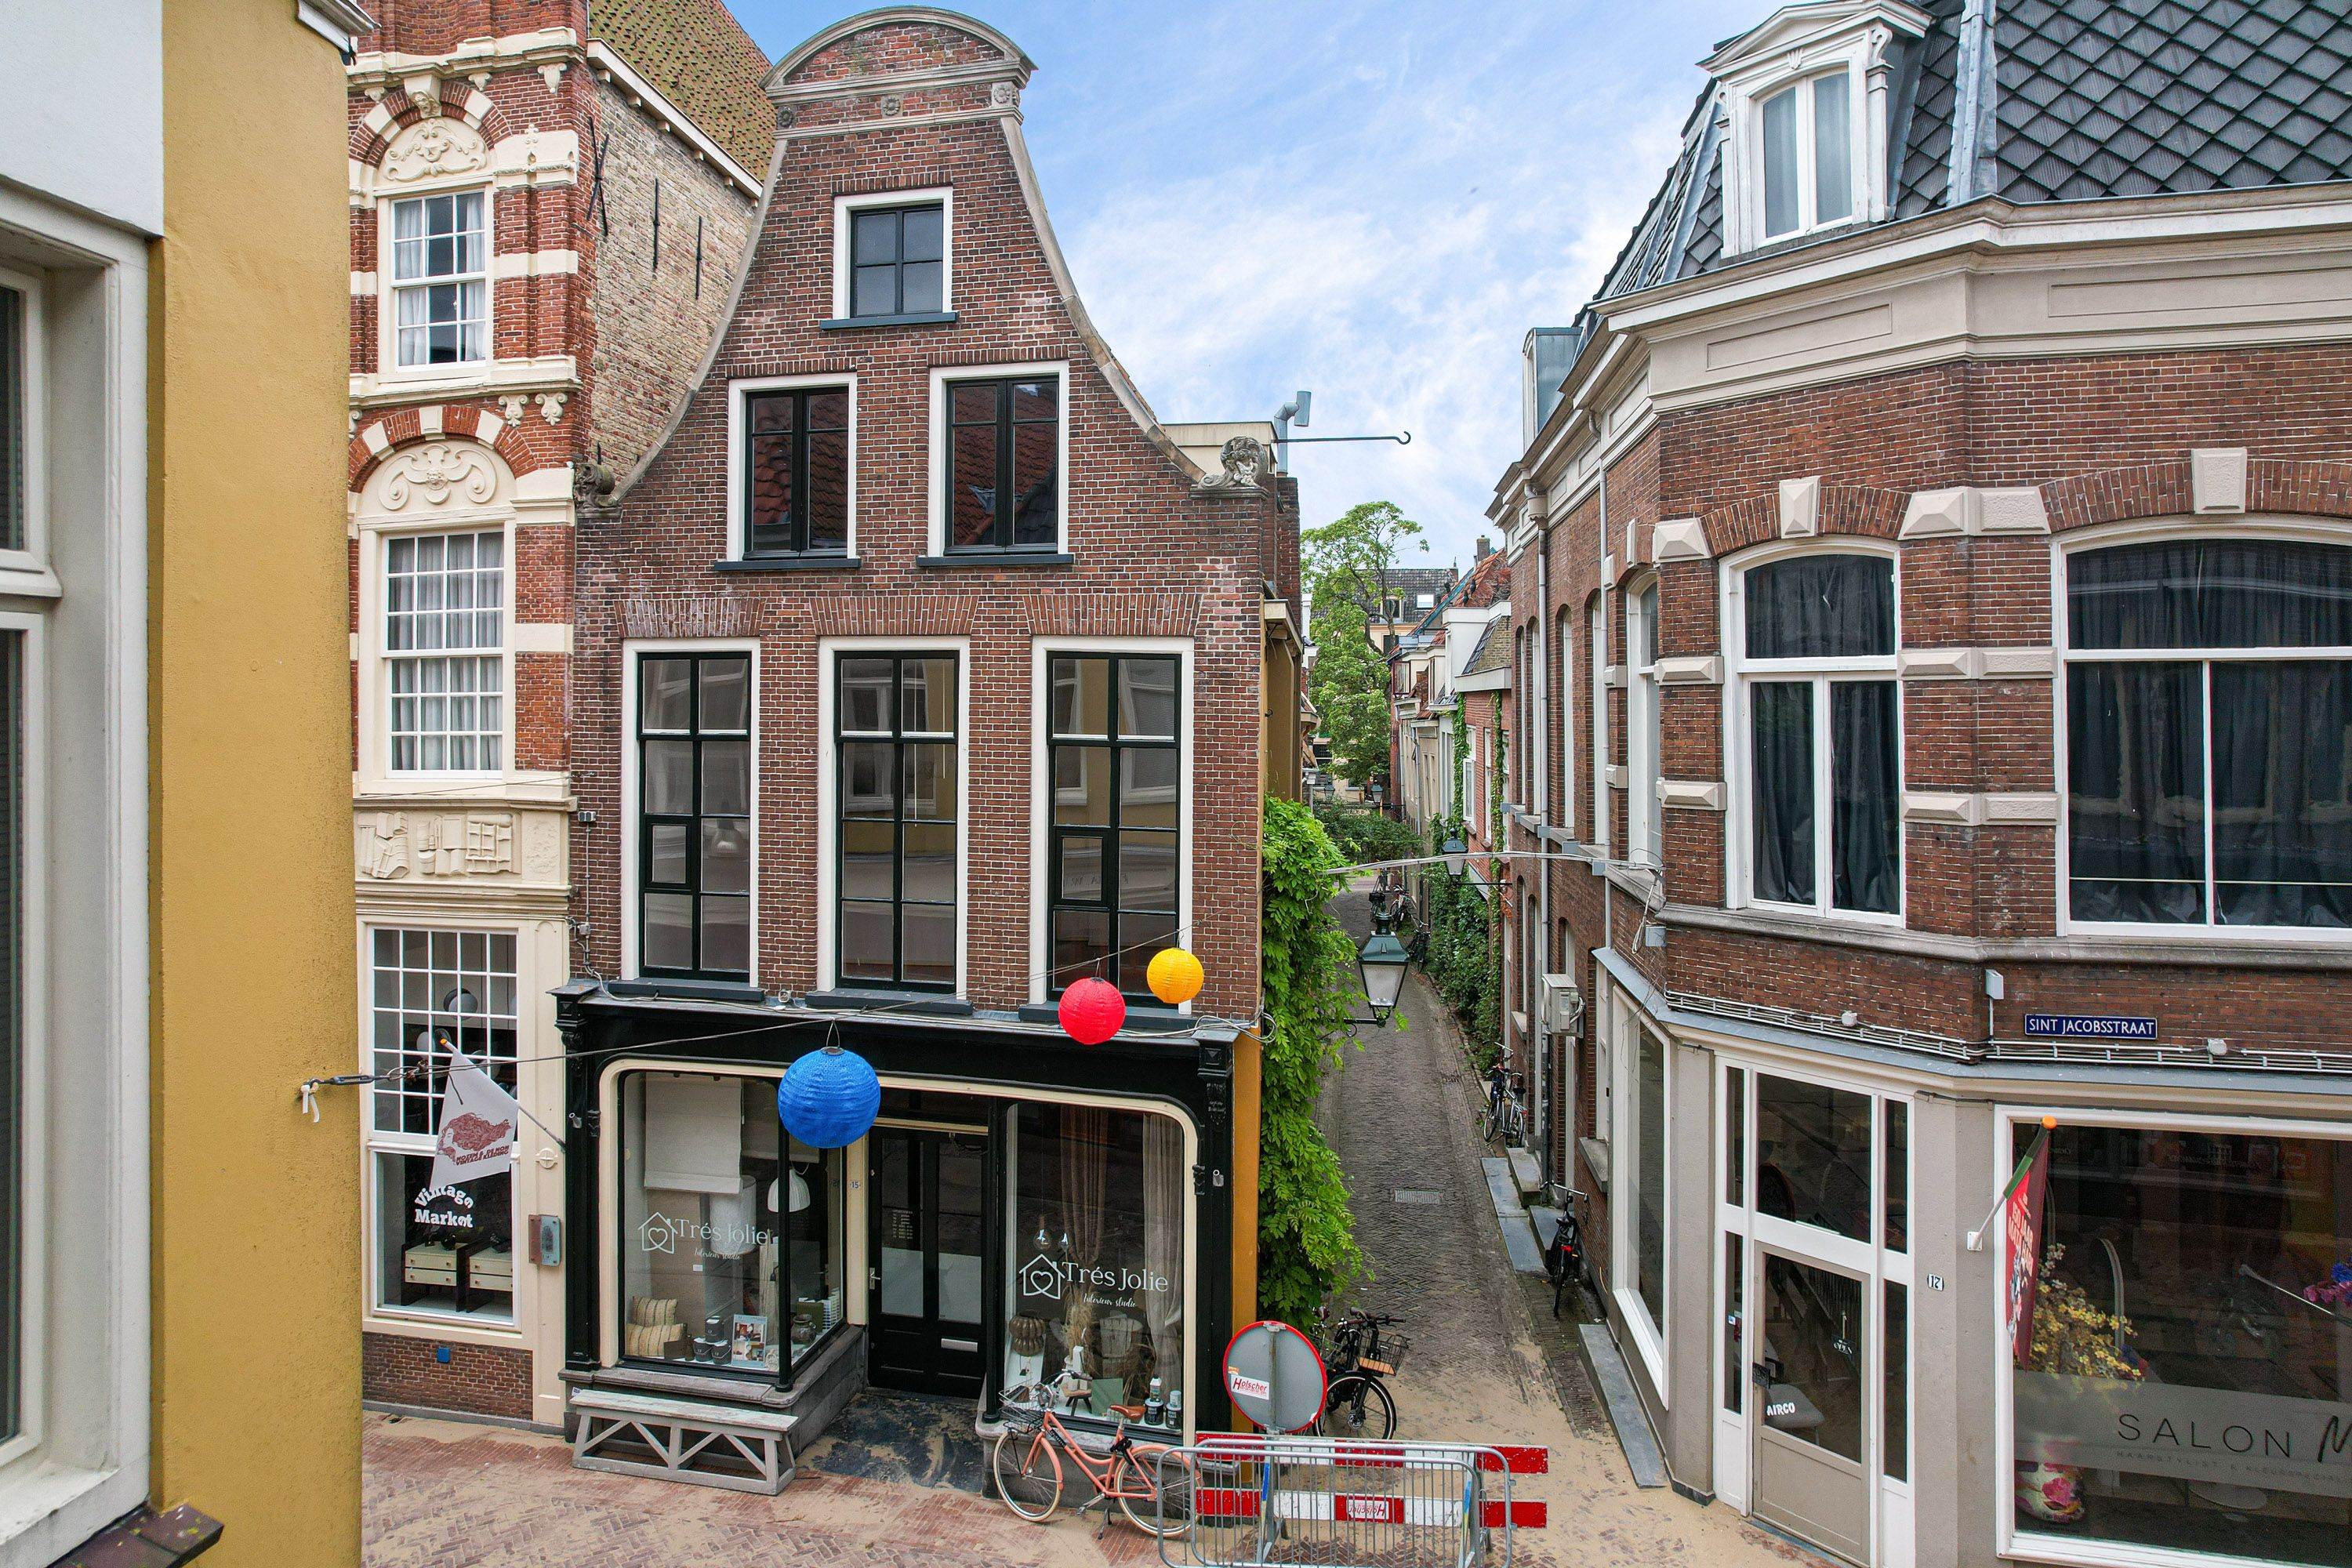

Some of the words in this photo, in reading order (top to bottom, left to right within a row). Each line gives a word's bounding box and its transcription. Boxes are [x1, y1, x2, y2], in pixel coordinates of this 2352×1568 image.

[2029, 1018, 2058, 1031] SINT
[2062, 1019, 2154, 1035] JACOBSSTRAAT
[456, 1155, 483, 1166] VINTAGE
[415, 1185, 474, 1209] Vintage
[415, 1208, 474, 1228] Market
[675, 1218, 722, 1242] Trés
[724, 1223, 768, 1247] Jolie
[1062, 1261, 1116, 1287] Trés
[1118, 1268, 1168, 1292] Jolie
[1931, 1275, 1941, 1289] 17
[1232, 1377, 1268, 1392] Holscher
[1766, 1402, 1796, 1417] AIRCO
[2118, 1414, 2290, 1458] SALON
